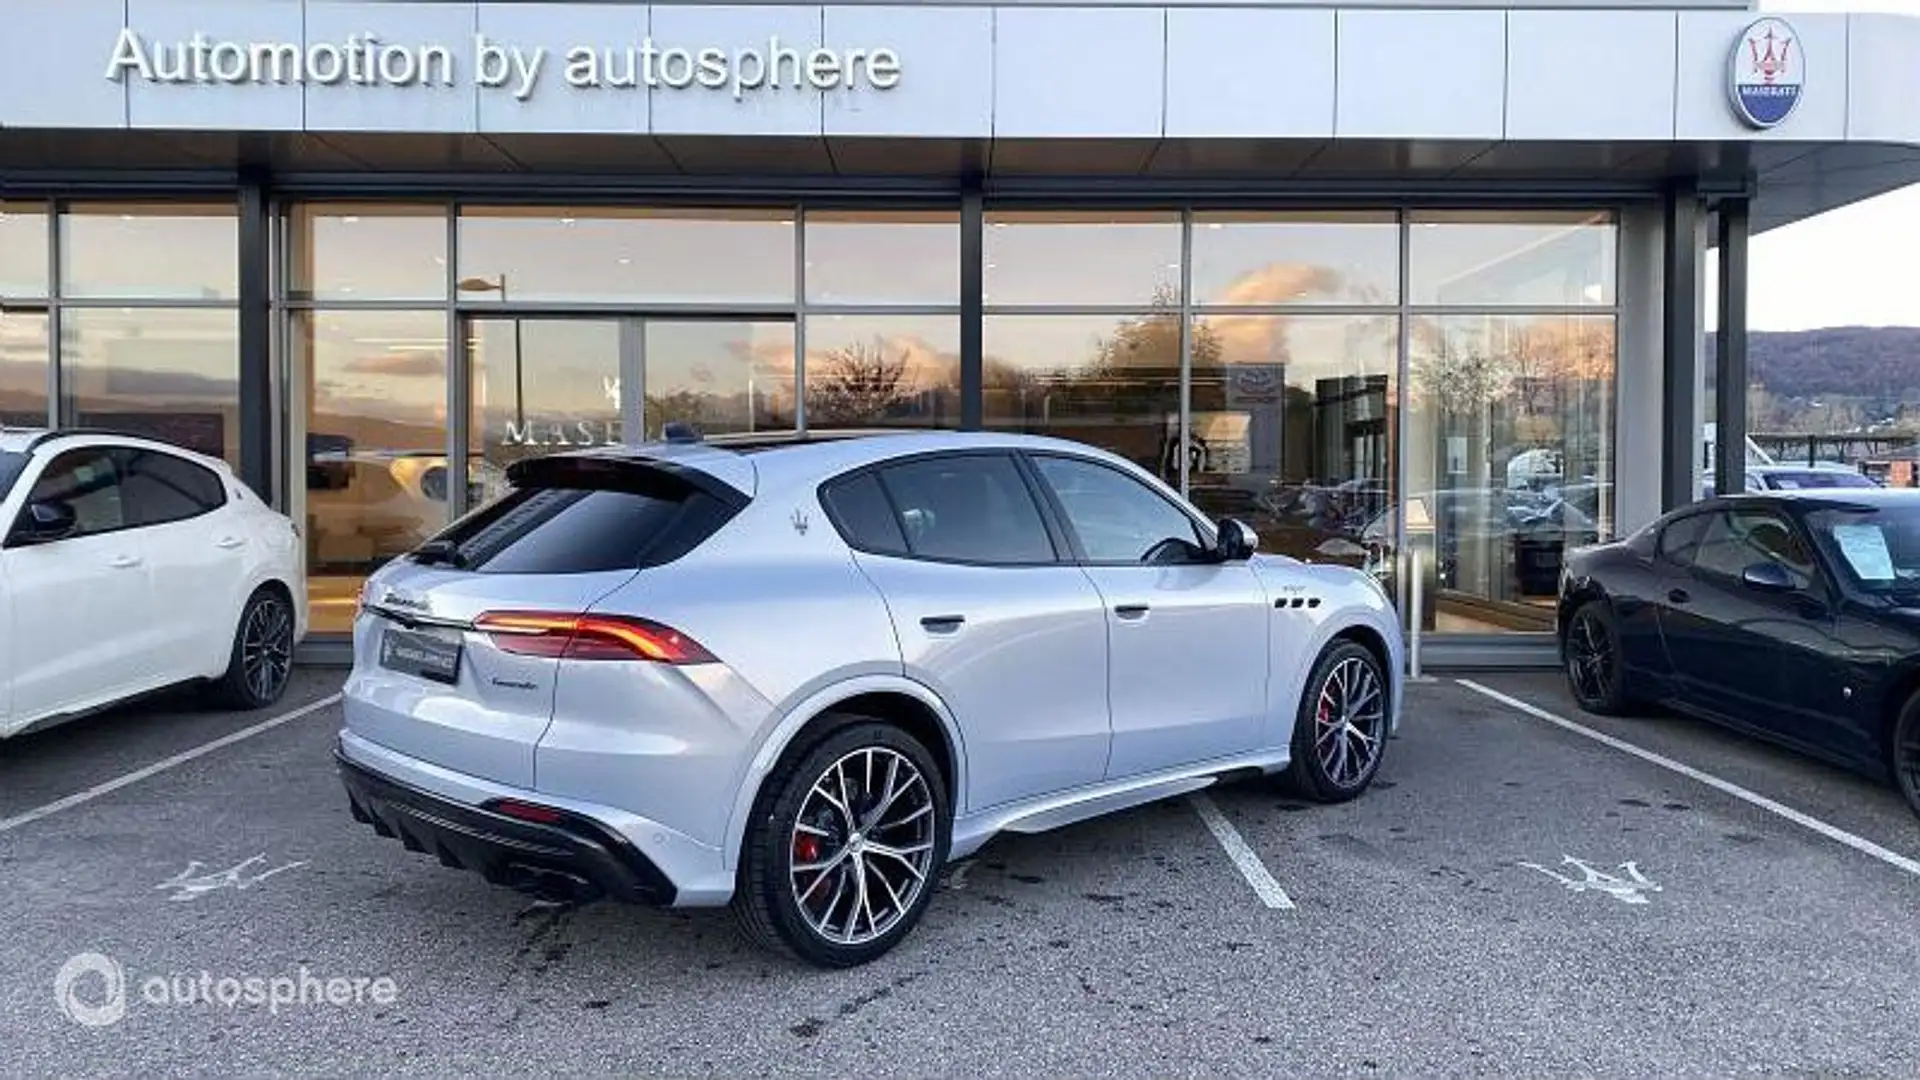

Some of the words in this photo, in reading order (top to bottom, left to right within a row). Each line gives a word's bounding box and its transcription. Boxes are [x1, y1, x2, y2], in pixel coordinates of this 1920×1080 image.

[107, 27, 452, 85] Automotion
[474, 33, 545, 99] by
[564, 36, 901, 99] autosphere
